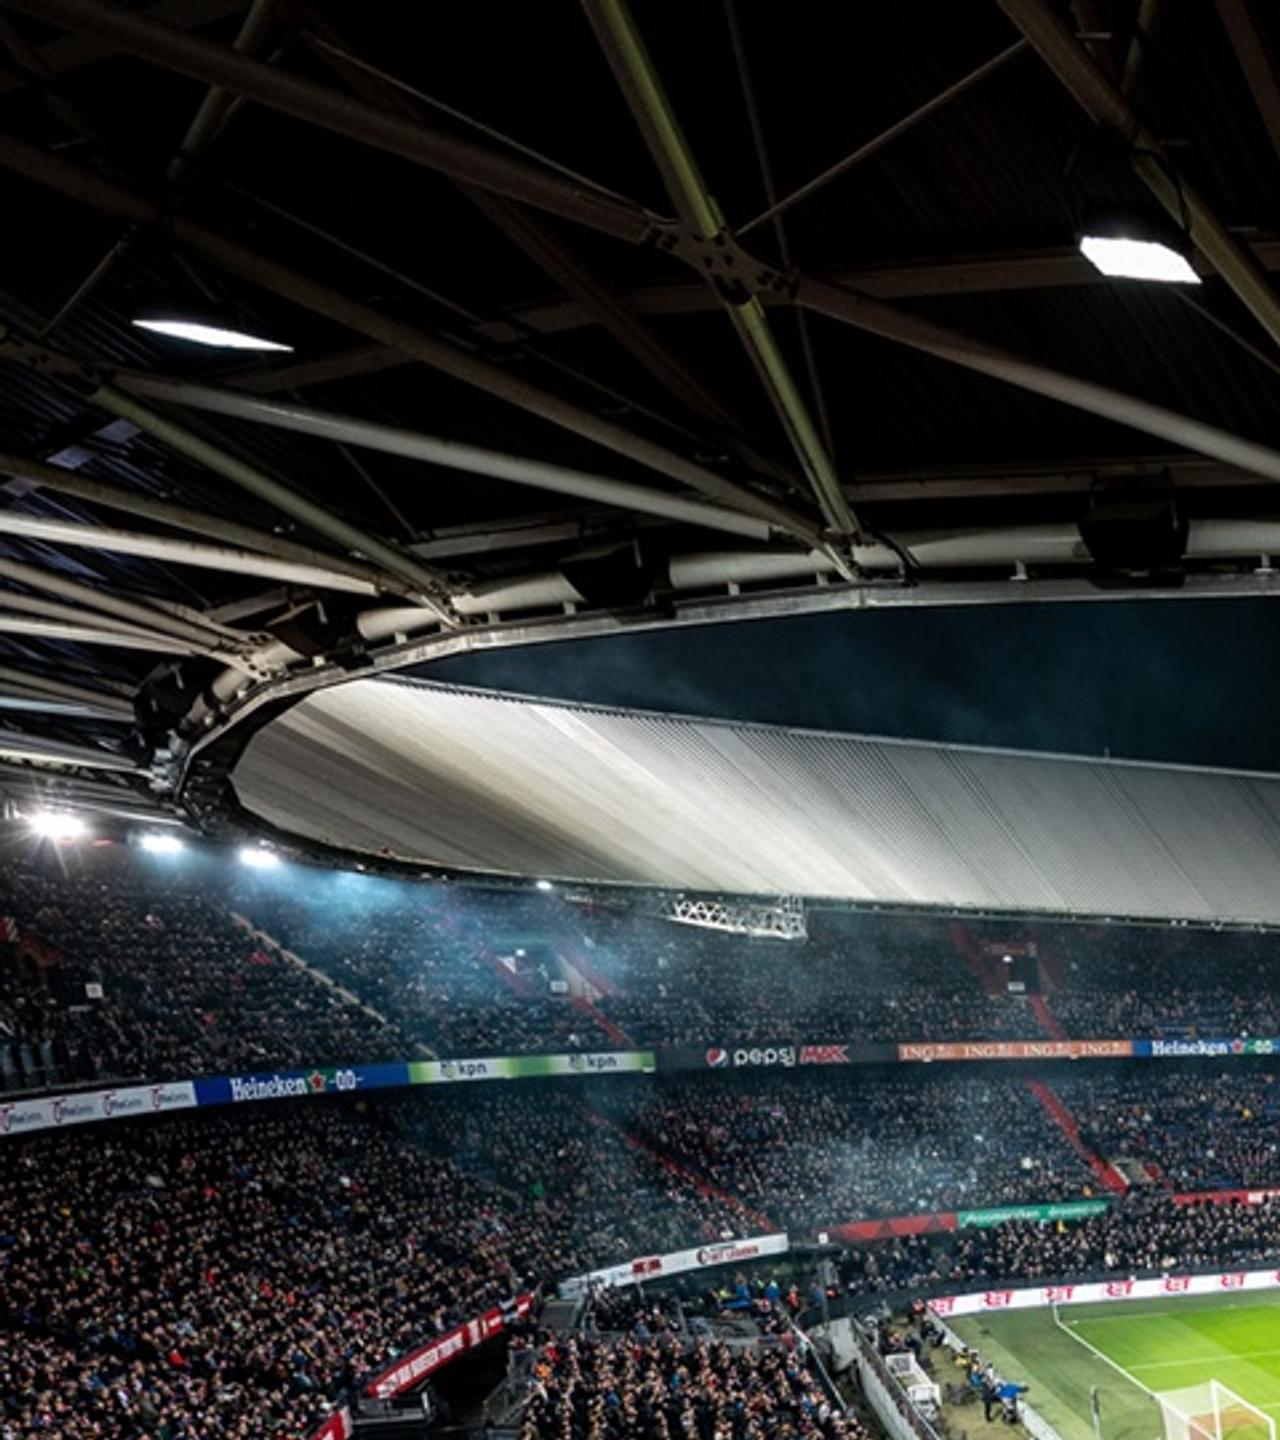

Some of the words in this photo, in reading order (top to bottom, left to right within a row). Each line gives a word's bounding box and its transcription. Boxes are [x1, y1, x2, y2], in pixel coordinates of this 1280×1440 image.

[1151, 1039, 1228, 1056] Heineken
[587, 1054, 617, 1071] kpn
[733, 1046, 796, 1068] pepsi
[458, 1061, 487, 1078] kpn
[229, 1074, 308, 1102] Heineken
